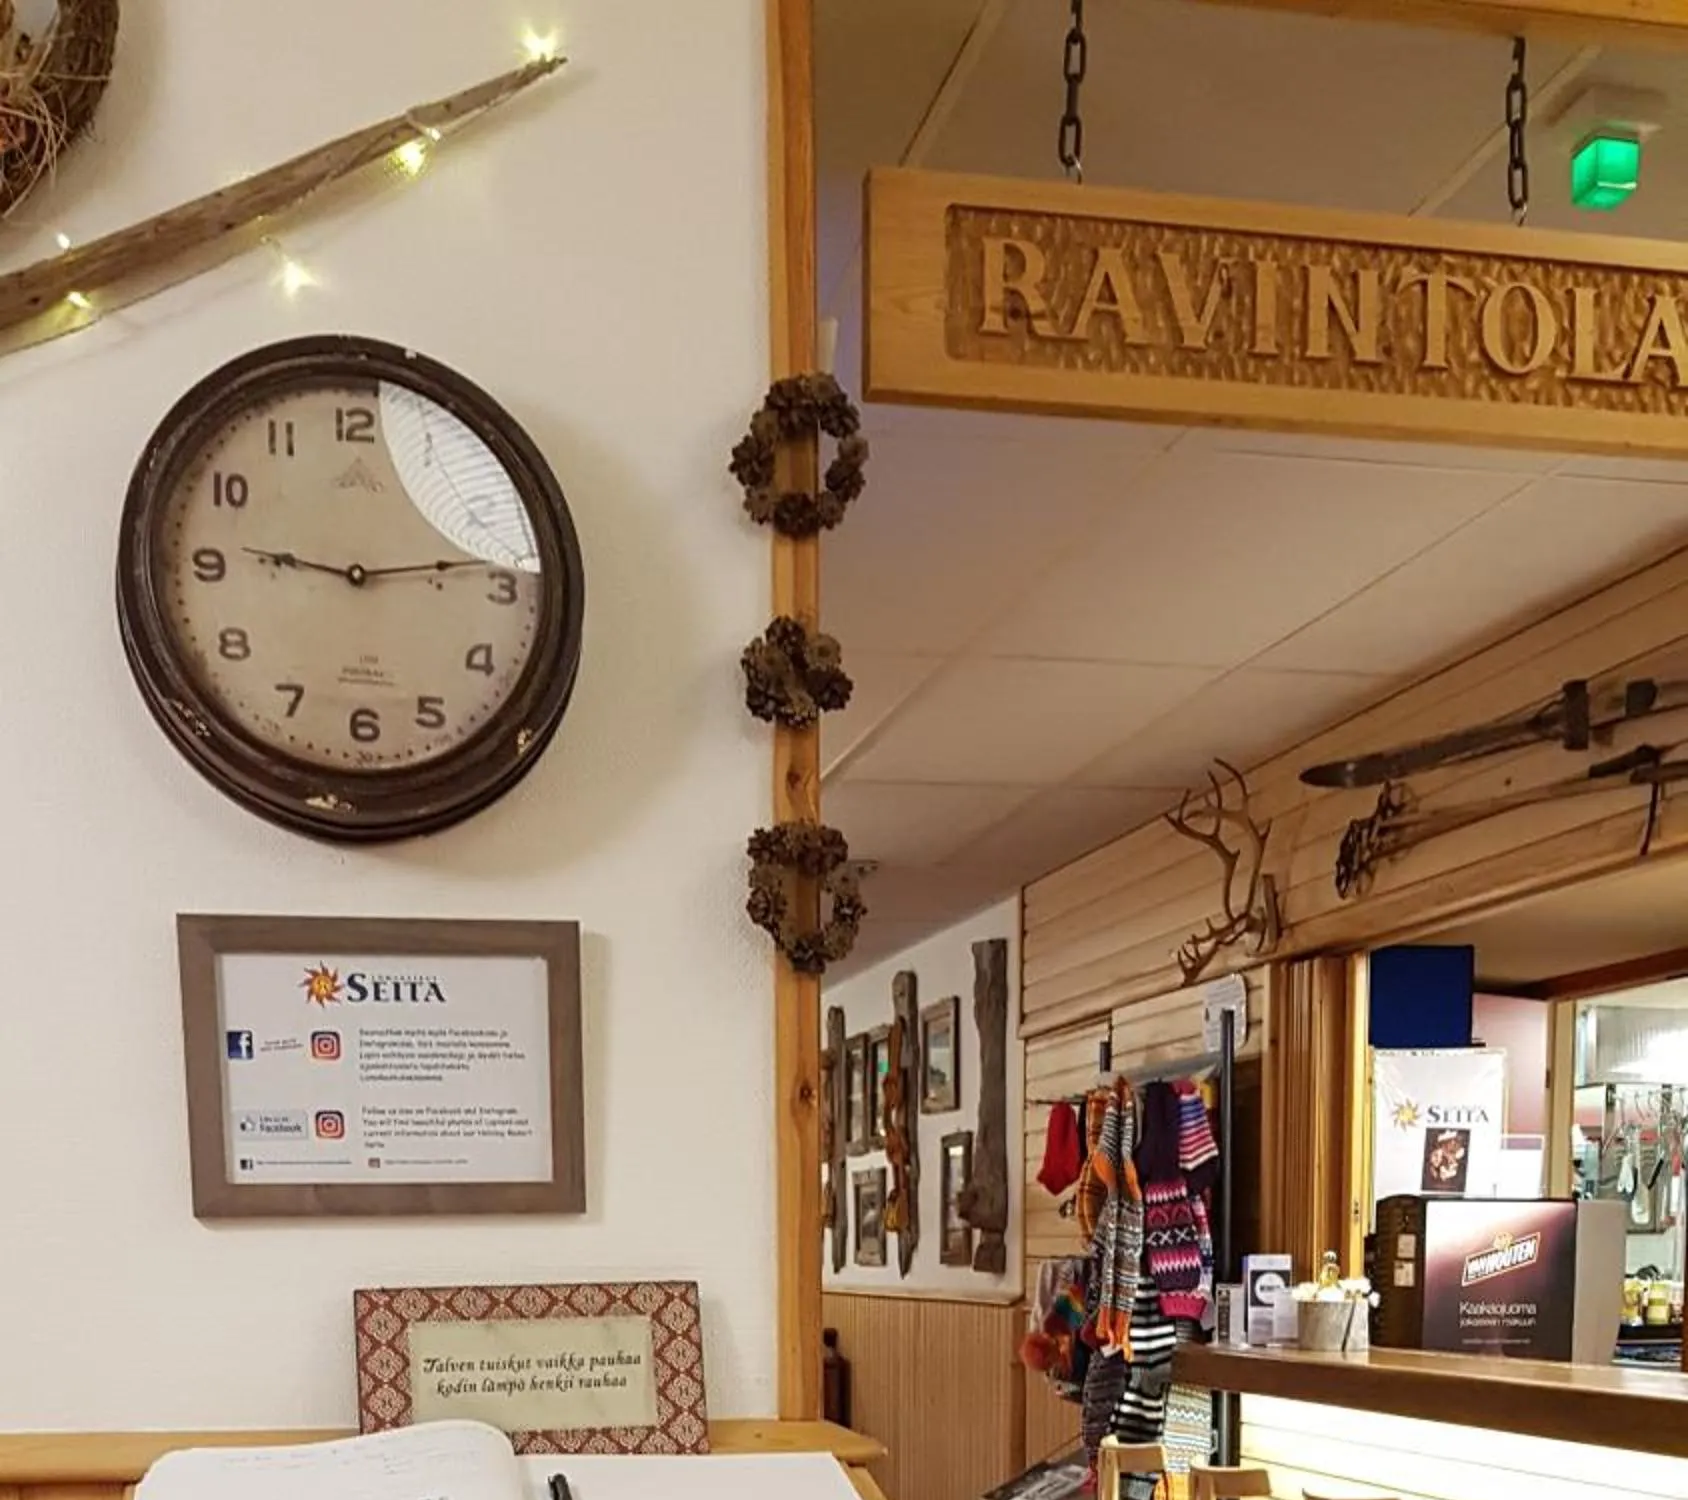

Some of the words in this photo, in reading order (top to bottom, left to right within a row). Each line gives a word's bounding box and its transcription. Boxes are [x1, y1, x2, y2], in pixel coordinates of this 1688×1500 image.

[977, 236, 1688, 389] RAVINTOLA
[267, 419, 296, 457] 11
[335, 407, 375, 444] 12
[212, 472, 249, 508] 10
[192, 548, 227, 583] 9
[486, 571, 519, 606] 3
[217, 627, 252, 661] 8
[465, 643, 495, 676] 4
[274, 683, 305, 719] 7
[415, 695, 446, 729] 5
[349, 707, 381, 743] 6
[346, 972, 447, 1003] SEITA
[422, 1356, 475, 1373] Talven
